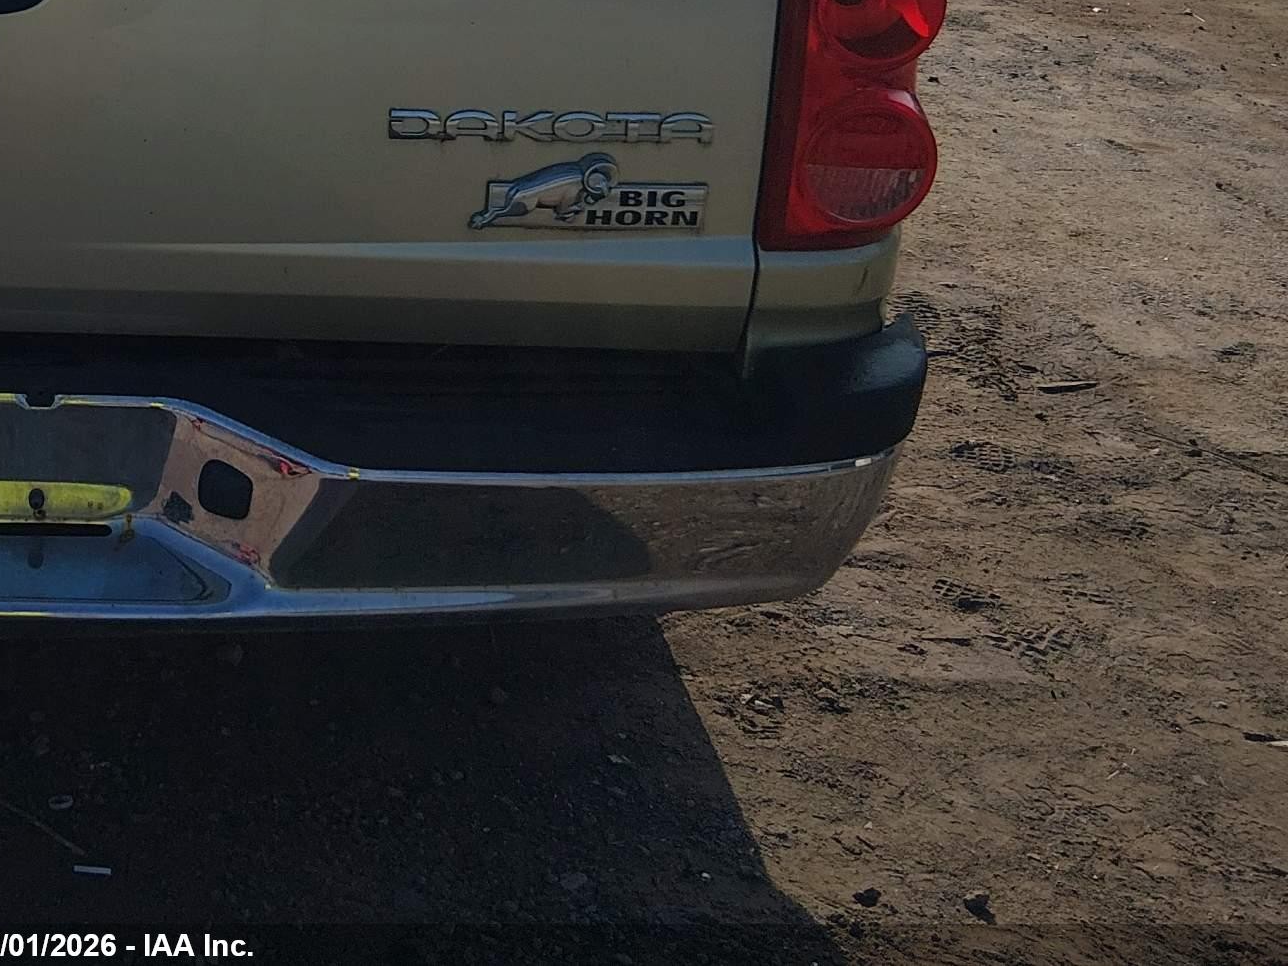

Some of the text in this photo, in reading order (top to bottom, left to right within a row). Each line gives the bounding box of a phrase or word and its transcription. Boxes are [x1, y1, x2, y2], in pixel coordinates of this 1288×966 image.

[389, 108, 715, 144] DAKOTA
[619, 191, 687, 208] BIG
[585, 210, 698, 227] HORN
